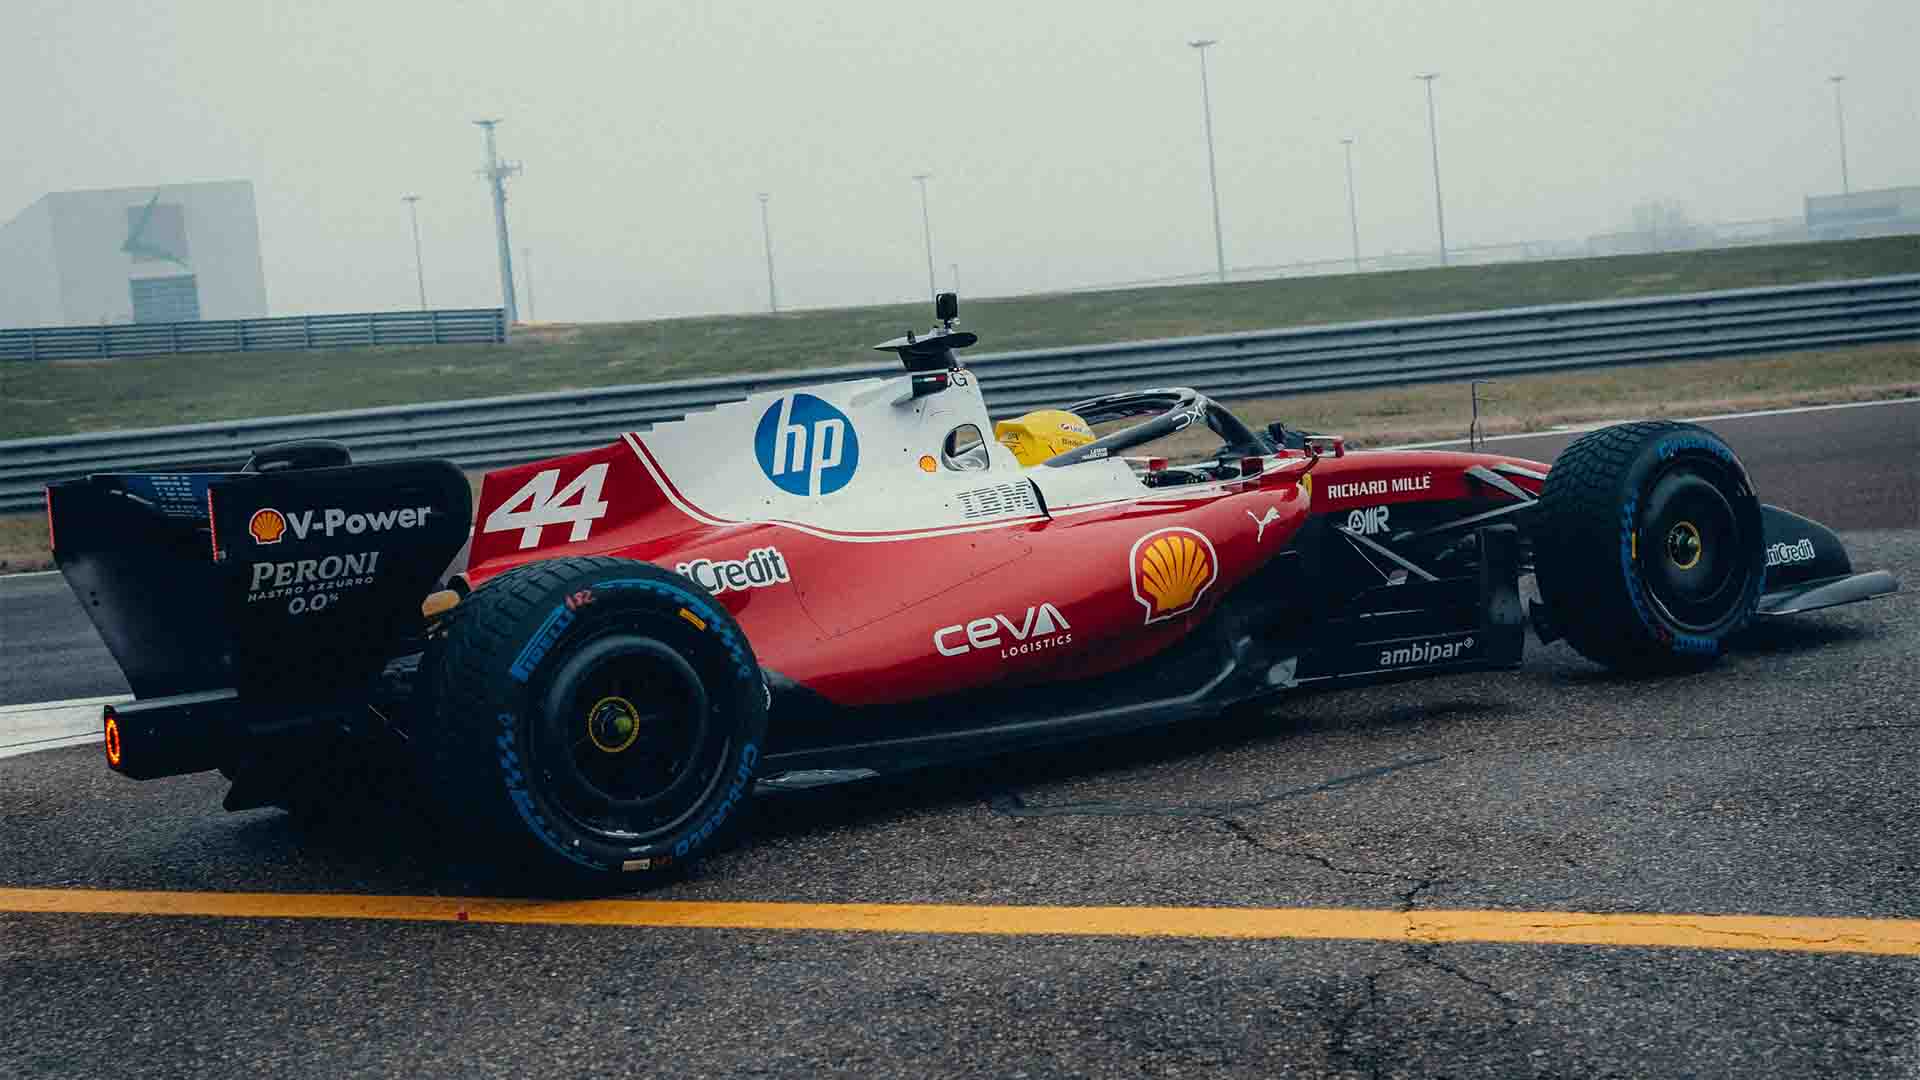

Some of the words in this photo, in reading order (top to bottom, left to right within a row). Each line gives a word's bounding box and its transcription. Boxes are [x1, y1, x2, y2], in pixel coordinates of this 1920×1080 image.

[772, 393, 845, 496] hp
[956, 480, 1035, 519] IBM
[1327, 479, 1388, 499] RICHARD
[1391, 475, 1432, 493] MILLE
[286, 505, 432, 540] V-Power
[483, 463, 609, 550] 44
[248, 585, 308, 602] NASTRO
[308, 575, 374, 593] AZZURRO
[249, 551, 379, 591] PERONI
[1001, 634, 1072, 658] LOGISTICS
[1380, 642, 1463, 666] ambipar
